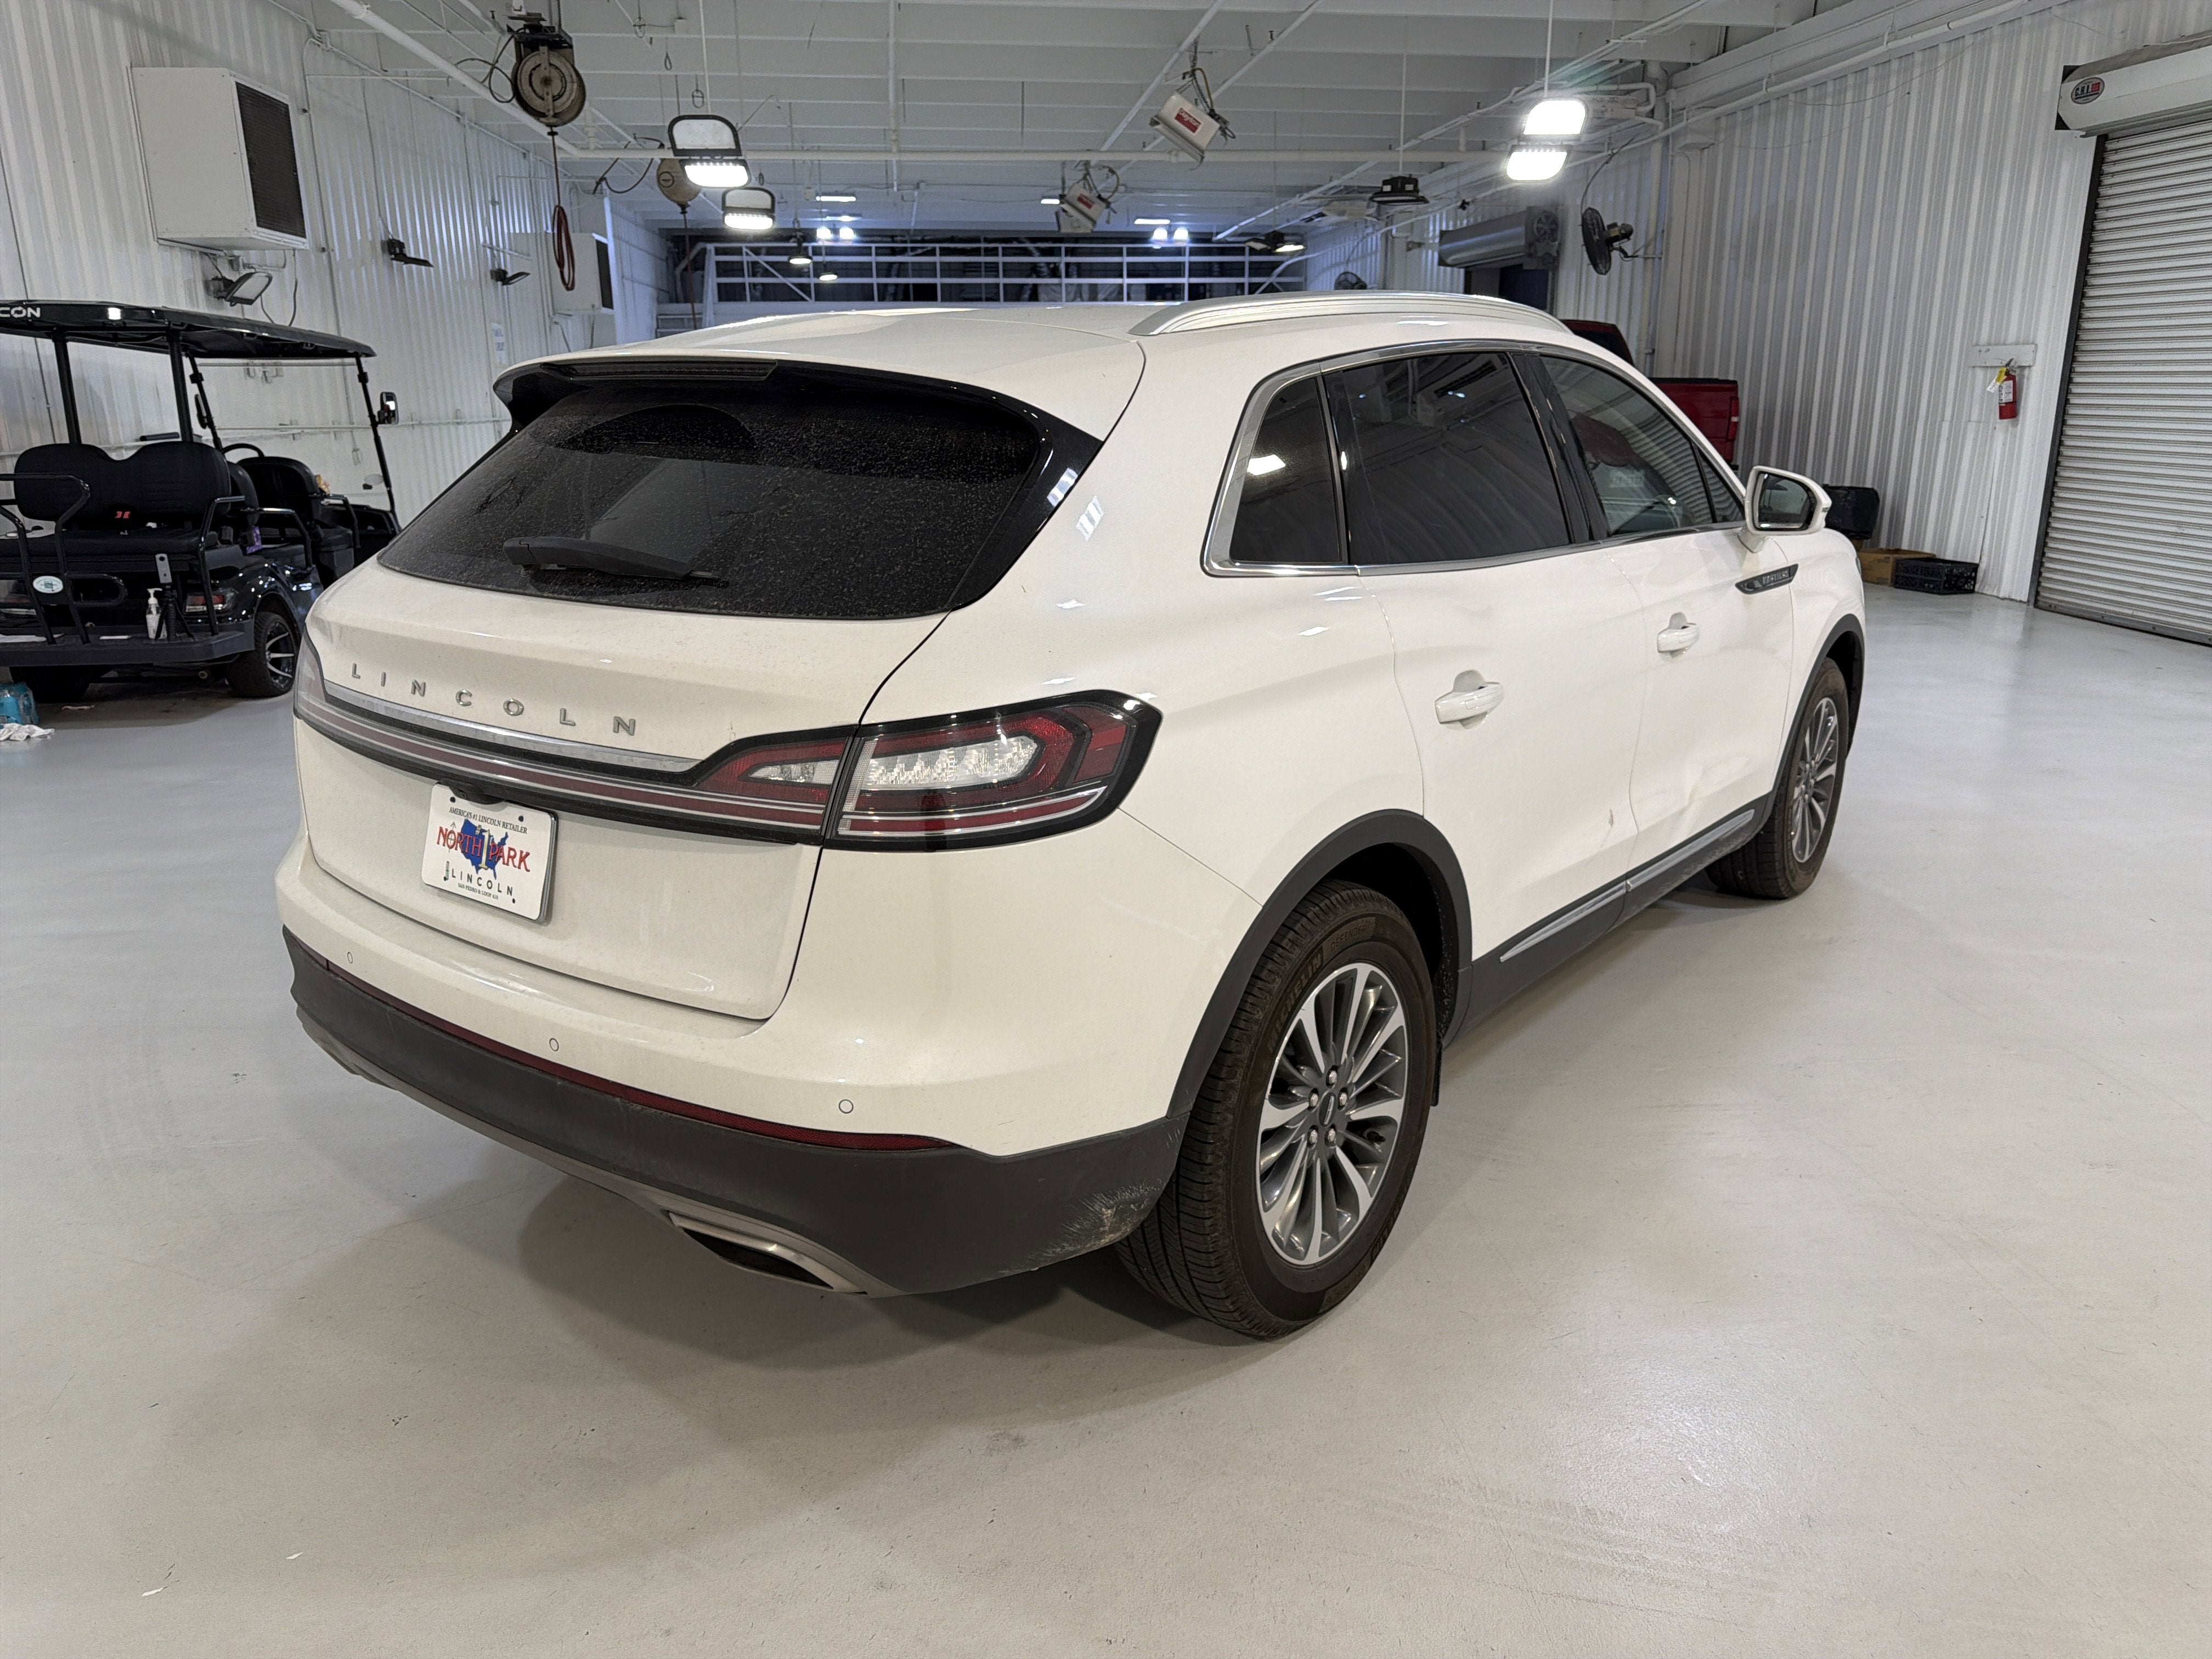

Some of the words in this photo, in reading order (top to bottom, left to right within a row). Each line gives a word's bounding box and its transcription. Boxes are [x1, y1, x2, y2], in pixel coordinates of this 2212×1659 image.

[351, 663, 635, 736] LINCOLN
[448, 806, 472, 820] AMERICA'S
[478, 814, 502, 827] LINCOLN
[501, 821, 528, 834] RETAILER
[437, 826, 482, 857] NORTH
[488, 842, 531, 872] PARK
[452, 868, 513, 896] LINCOLN
[465, 884, 477, 893] PEDRO
[481, 890, 492, 898] LOOP
